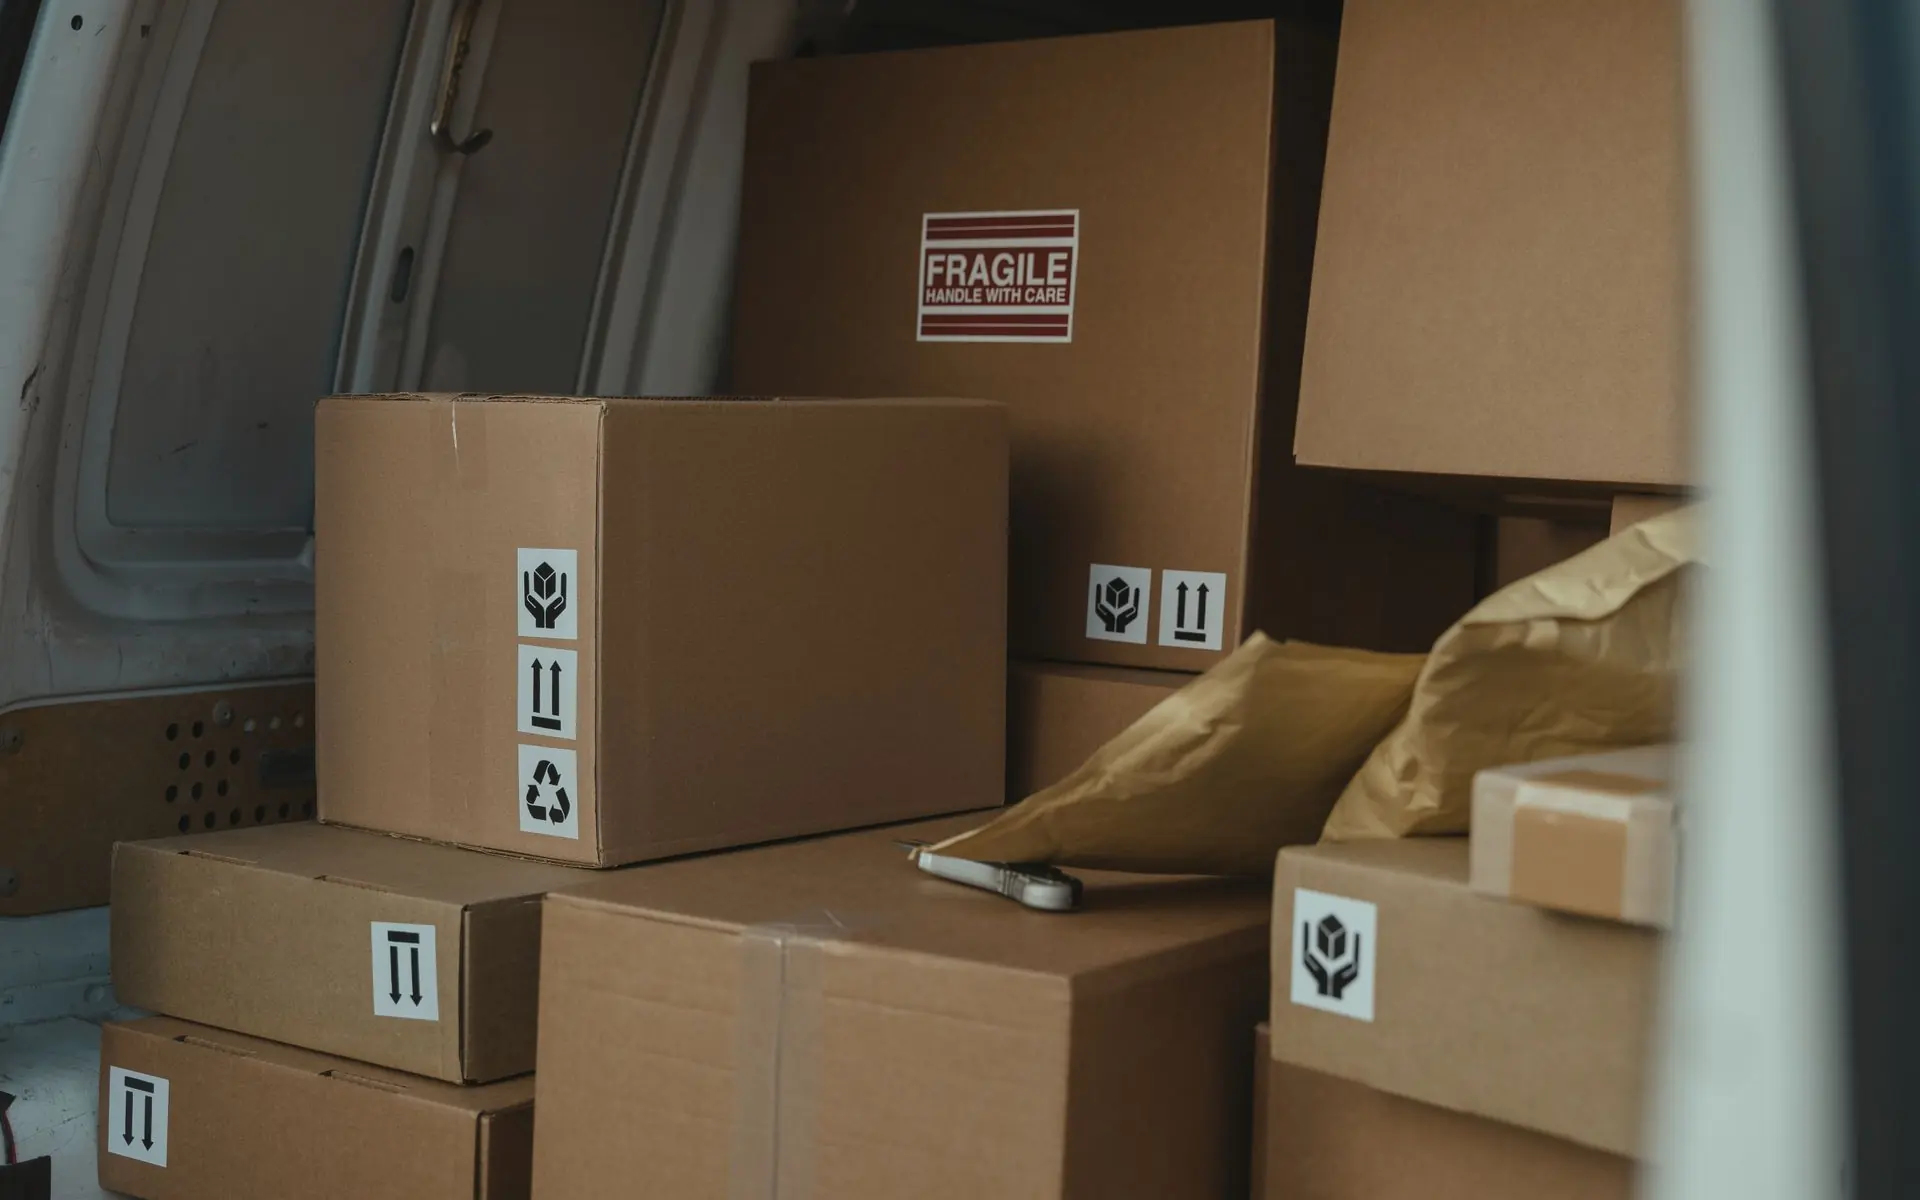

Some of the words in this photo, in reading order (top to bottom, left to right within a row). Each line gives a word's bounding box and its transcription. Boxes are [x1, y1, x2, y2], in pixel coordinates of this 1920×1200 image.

[926, 252, 1068, 286] FRAGILE
[925, 288, 982, 303] HANDLE
[986, 287, 1021, 303] WITH
[1024, 287, 1066, 303] CARE
